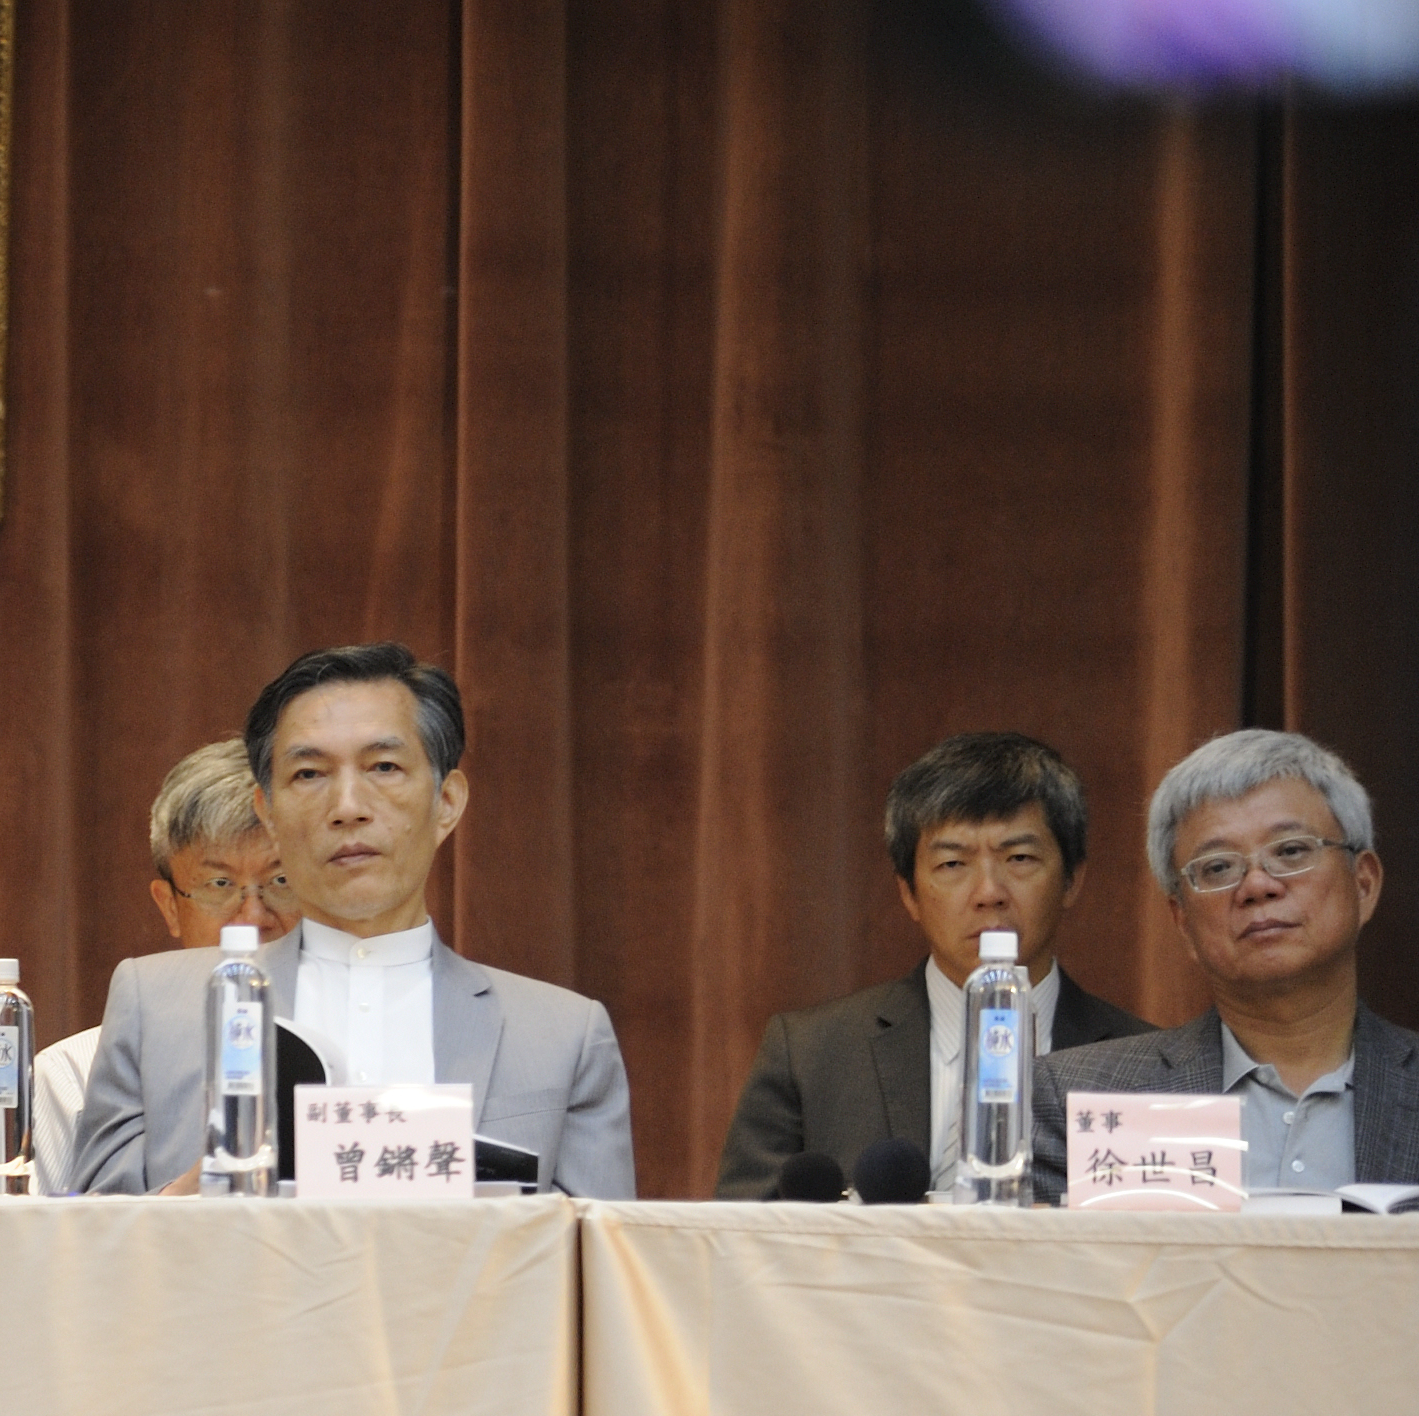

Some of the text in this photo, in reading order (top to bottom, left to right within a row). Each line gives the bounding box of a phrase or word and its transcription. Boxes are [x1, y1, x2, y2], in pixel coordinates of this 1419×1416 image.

[306, 1100, 407, 1124] 副董事長
[1075, 1109, 1123, 1133] 董事
[1085, 1148, 1217, 1187] 徐世昌
